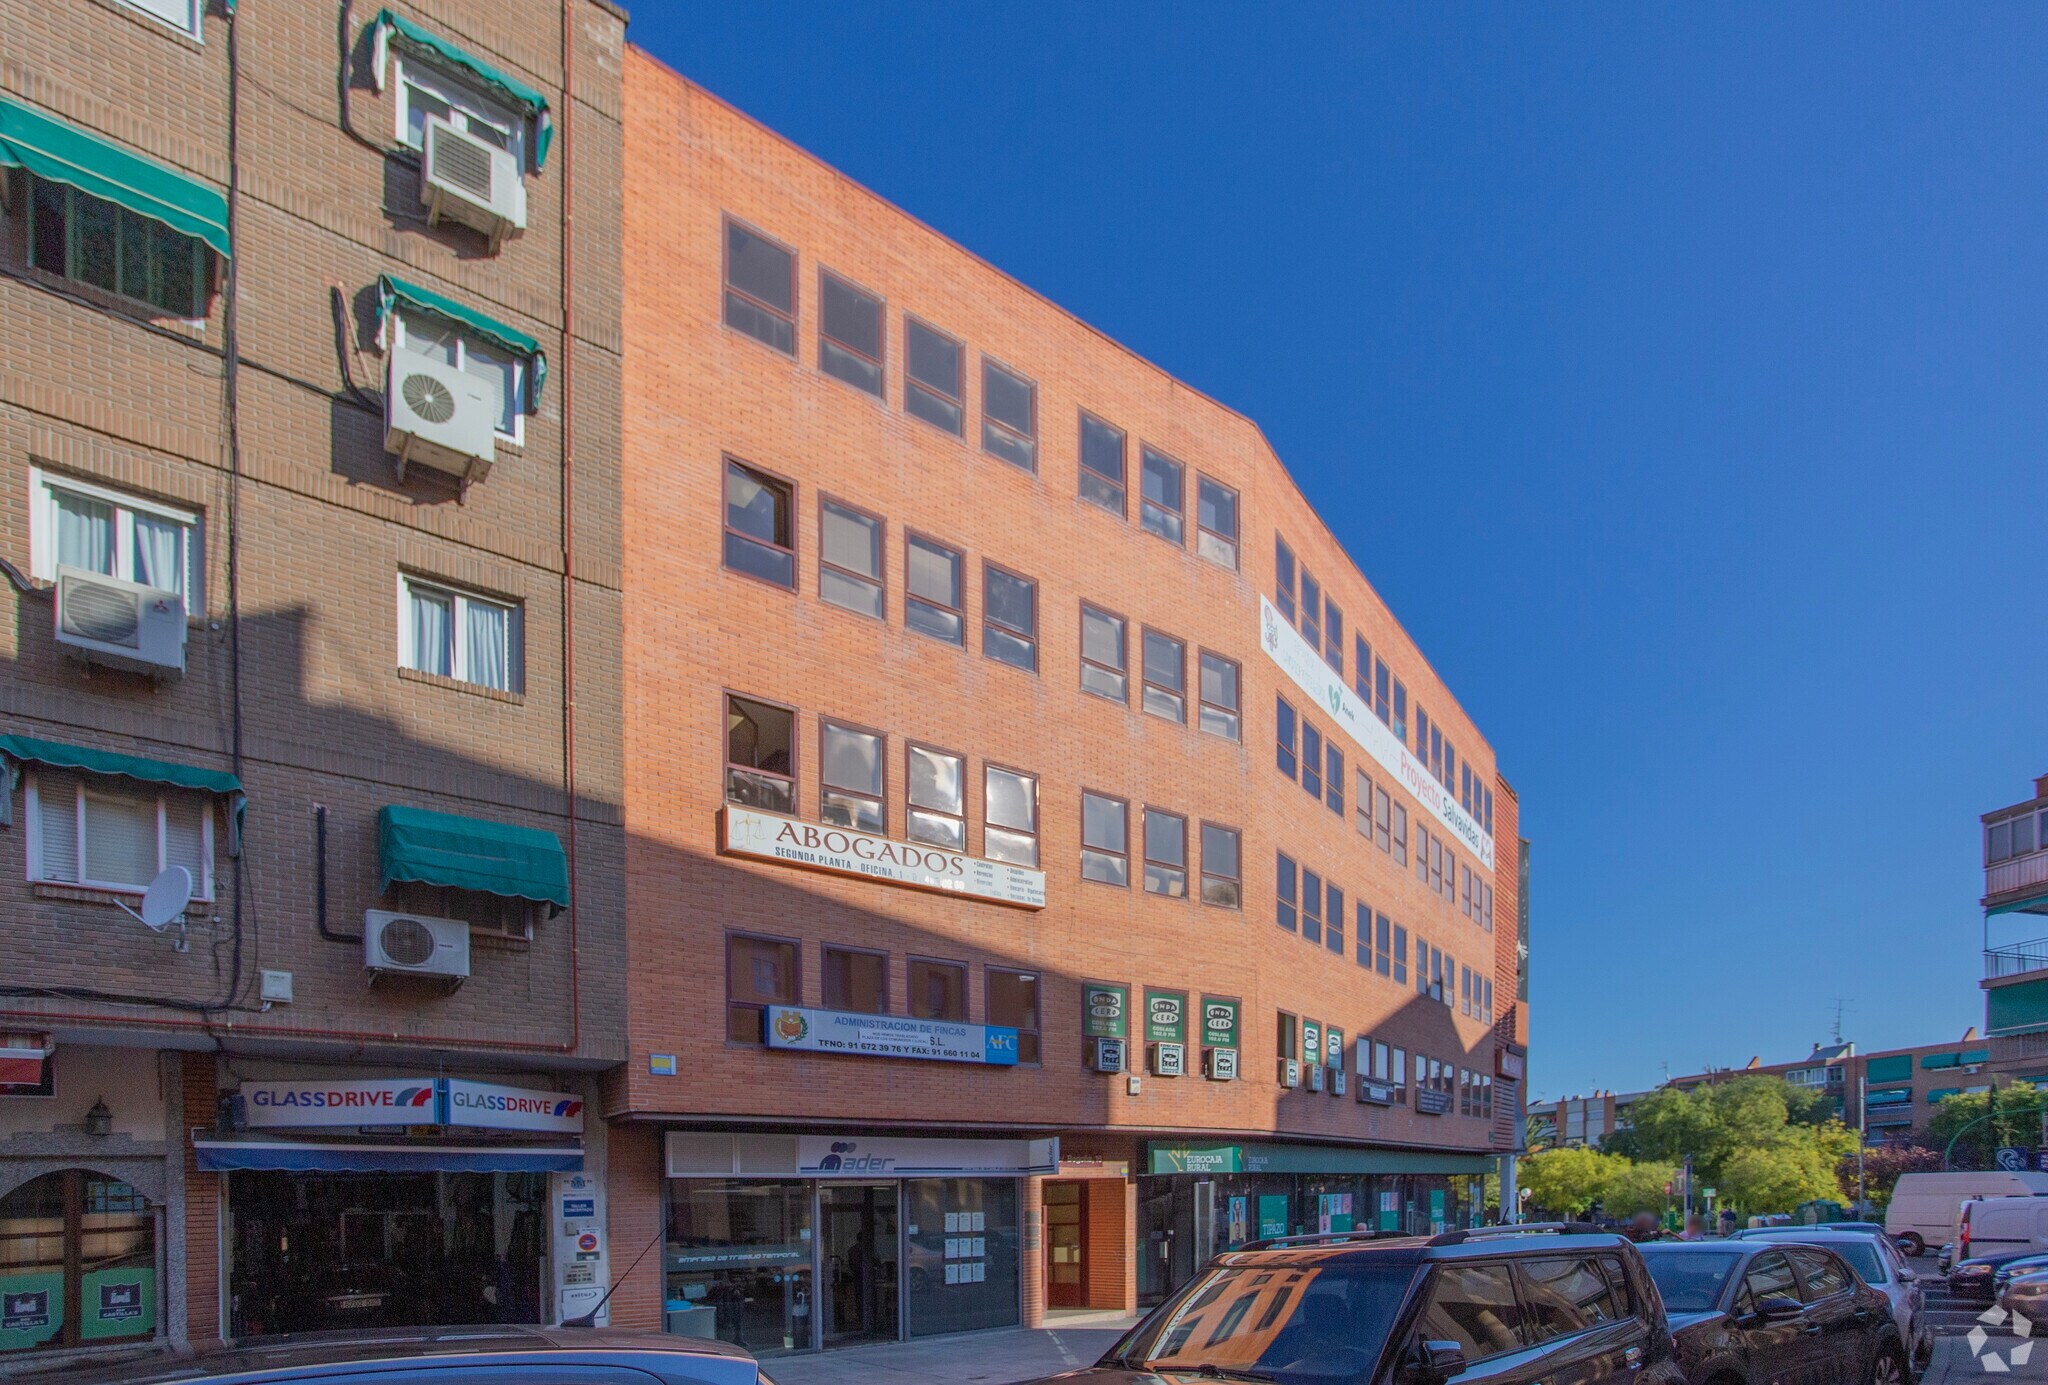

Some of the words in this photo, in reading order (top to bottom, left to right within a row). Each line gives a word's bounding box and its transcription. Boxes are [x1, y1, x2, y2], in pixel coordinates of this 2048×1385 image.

[1401, 750, 1440, 811] Proyecto
[1443, 796, 1479, 849] Salvavidas
[775, 822, 964, 876] ABOGADOS
[775, 846, 815, 863] SEGUNDA
[818, 855, 851, 869] PLANTA
[1093, 995, 1117, 1004] ONDA
[834, 1016, 917, 1032] ADMINISTRACION
[920, 1024, 932, 1034] DE
[934, 1025, 966, 1036] FINCAS
[818, 1040, 846, 1048] TFNO:
[861, 1043, 876, 1051] 672
[930, 1036, 945, 1047] S.L.
[986, 1034, 1018, 1050] AFC
[253, 1090, 393, 1107] GLASSDRIVE
[453, 1092, 551, 1114] GLASSDRIVE
[1186, 1156, 1224, 1164] EUROCAJA
[1186, 1164, 1211, 1172] RURAL
[6, 1320, 45, 1328] CASTILLA'S
